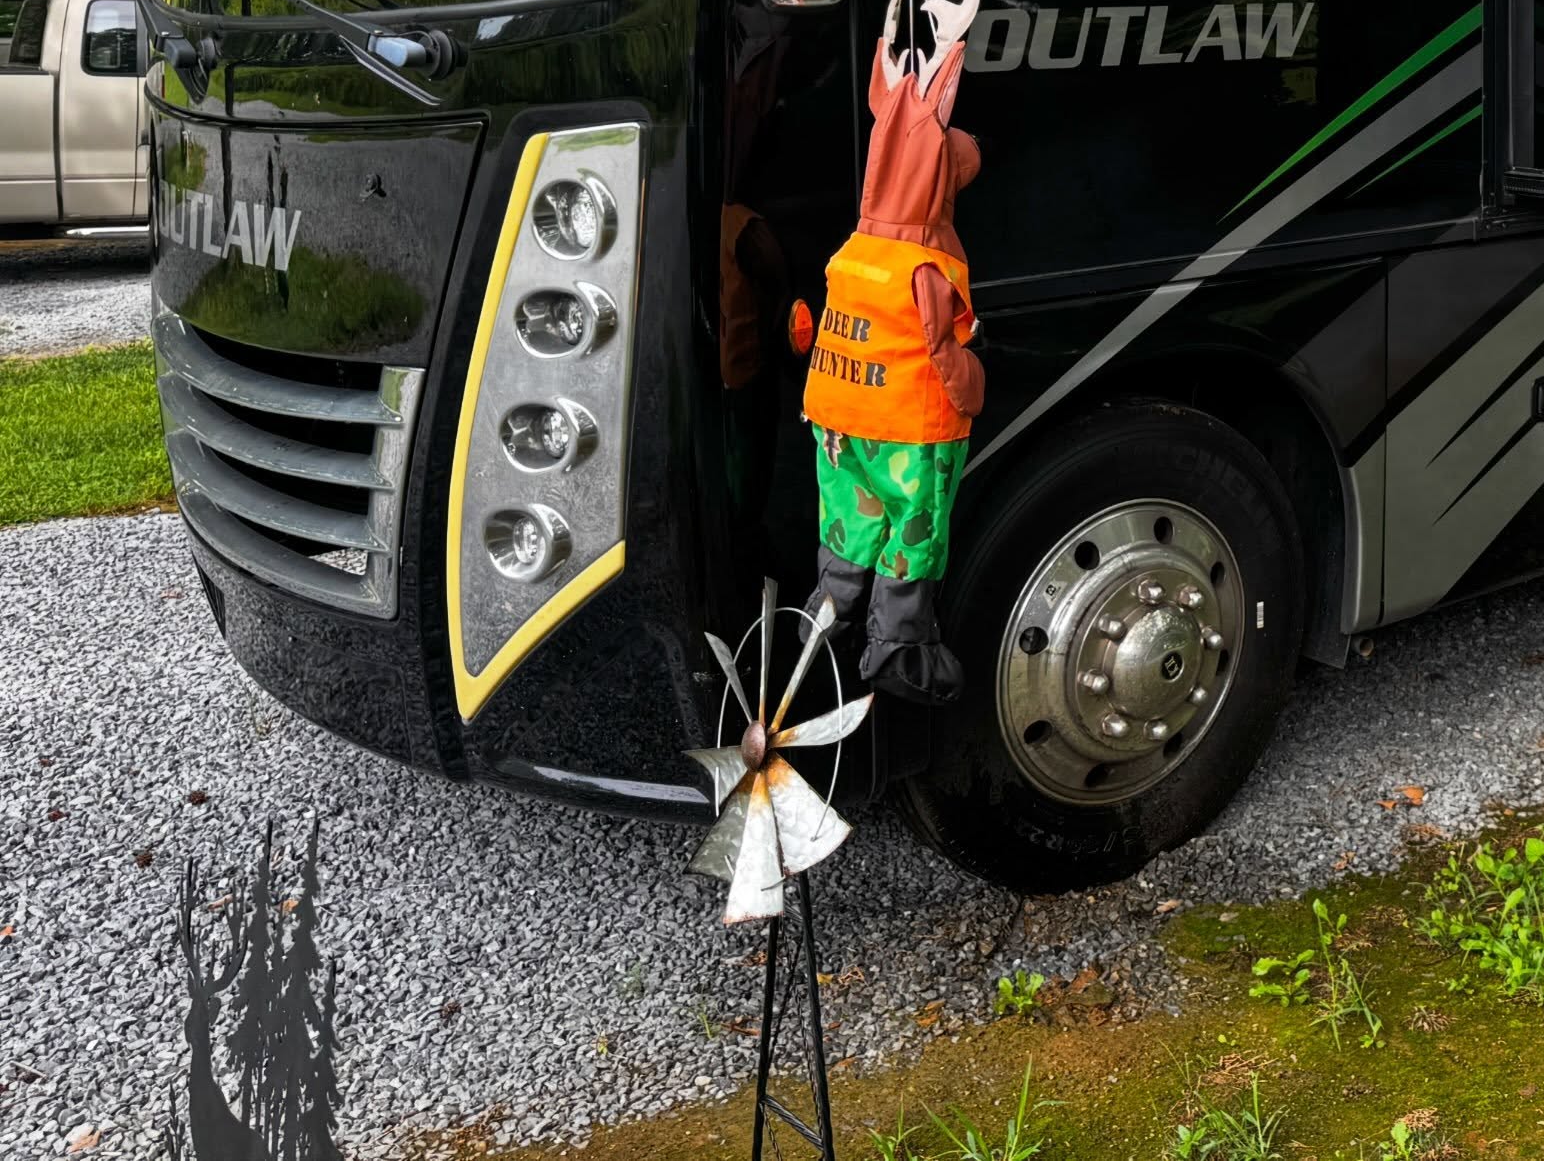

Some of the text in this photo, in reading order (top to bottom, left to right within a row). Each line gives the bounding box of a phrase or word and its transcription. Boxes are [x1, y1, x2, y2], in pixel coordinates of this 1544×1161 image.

[963, 2, 1314, 73] OUTLAW
[158, 178, 302, 271] OUTLAW
[823, 307, 872, 342] DEER
[811, 345, 887, 387] HUNTER
